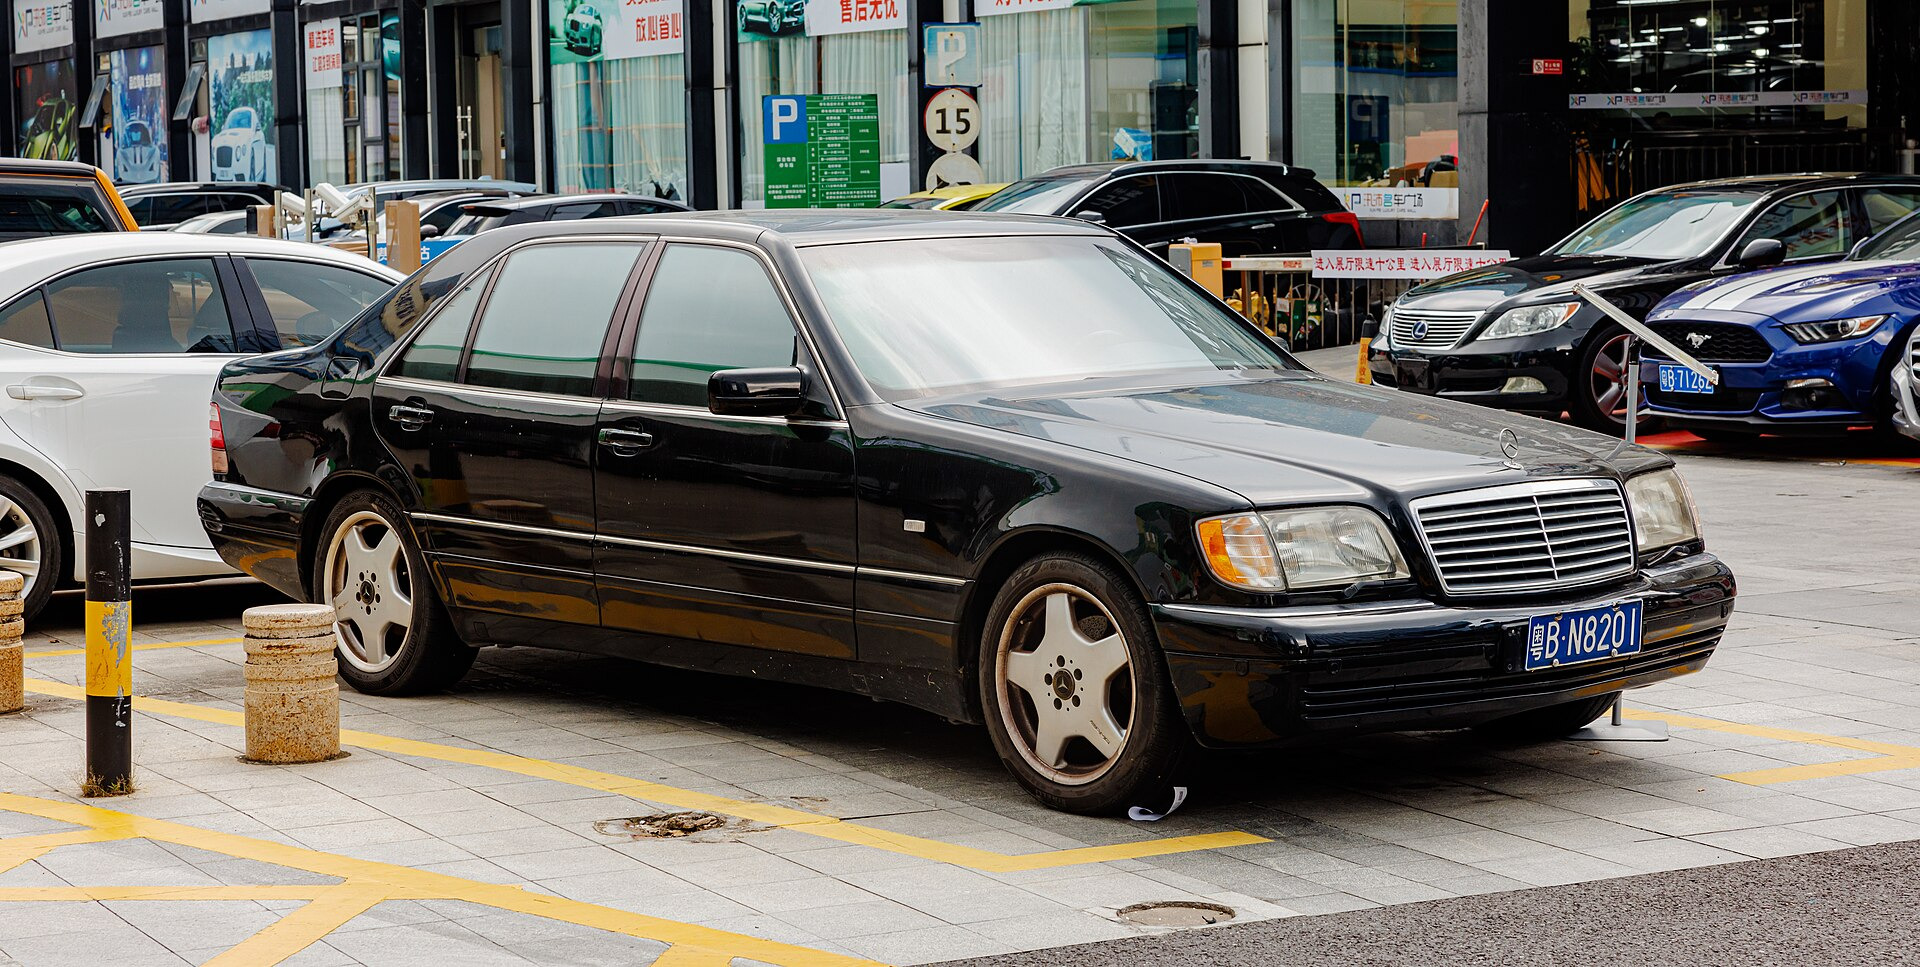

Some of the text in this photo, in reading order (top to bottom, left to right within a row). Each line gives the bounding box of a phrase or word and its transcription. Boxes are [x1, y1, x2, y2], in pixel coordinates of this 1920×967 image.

[636, 12, 682, 42] 放心省心
[937, 31, 967, 79] P
[772, 98, 798, 140] P
[935, 108, 970, 135] 15
